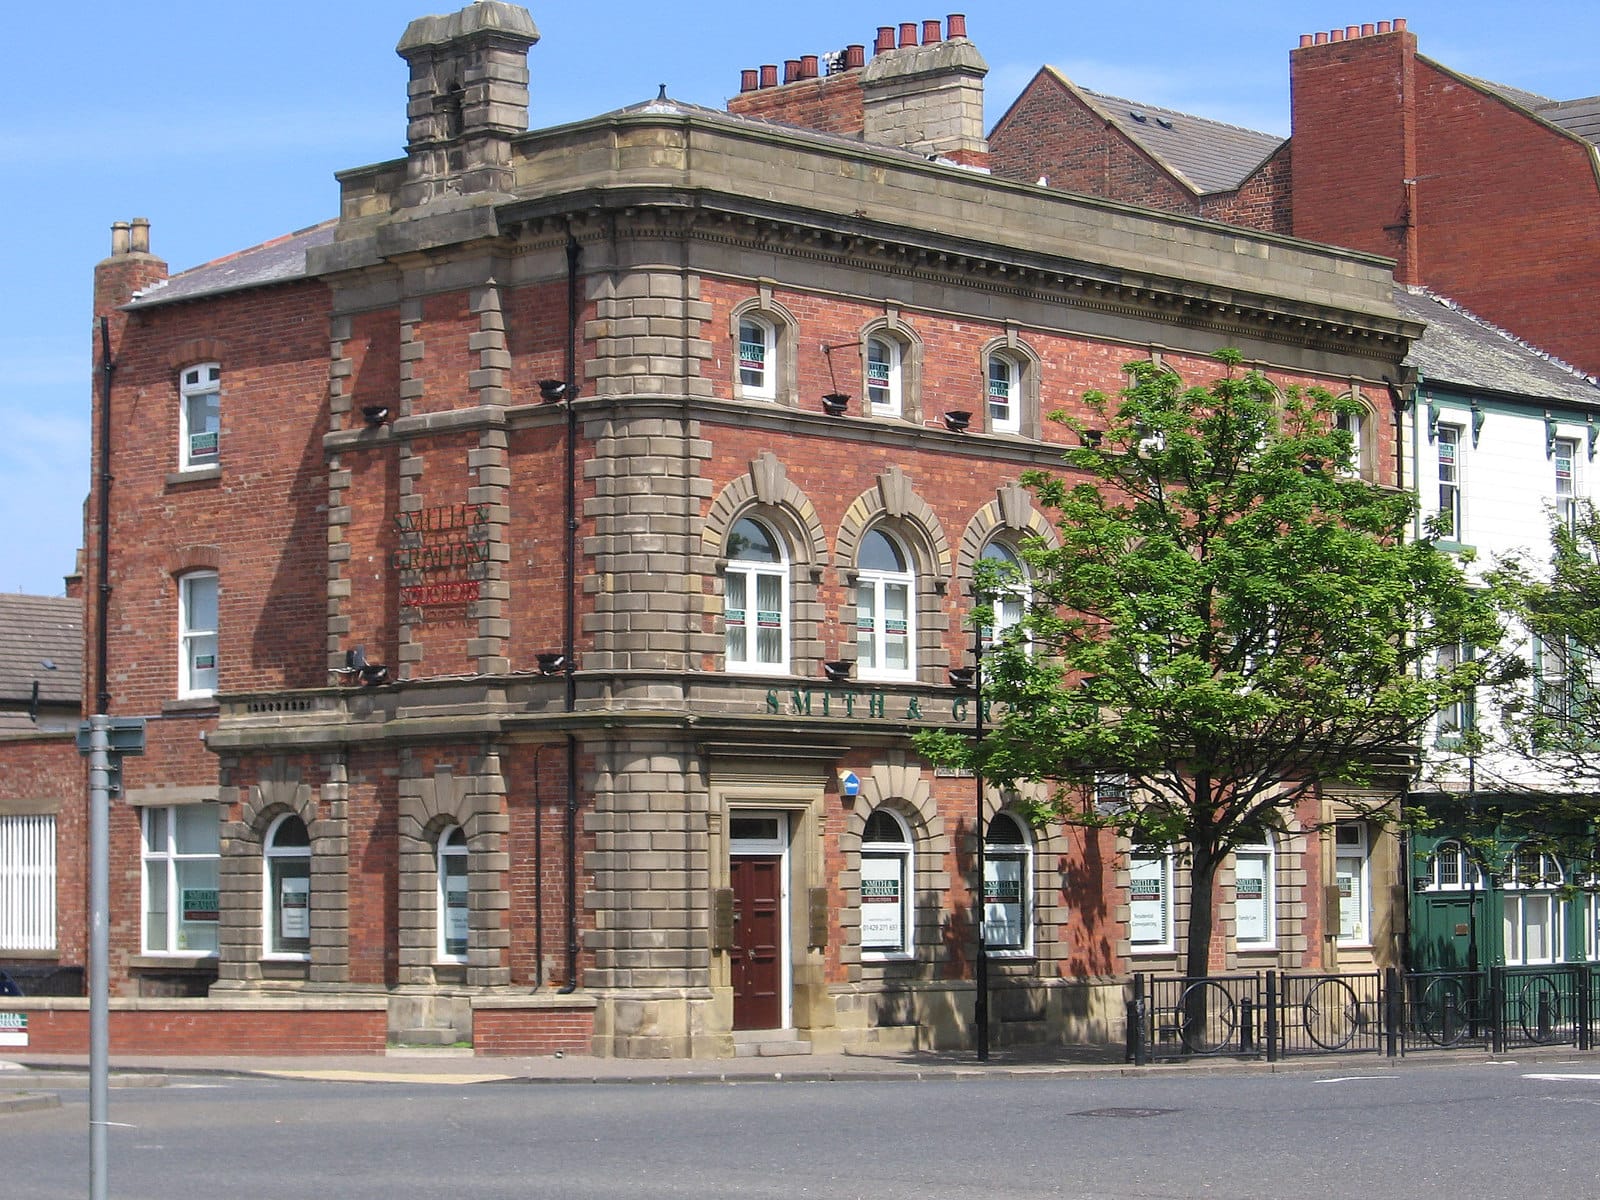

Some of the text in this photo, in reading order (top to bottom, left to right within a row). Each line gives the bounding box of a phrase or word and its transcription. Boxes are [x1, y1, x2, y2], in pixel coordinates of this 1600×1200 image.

[391, 540, 490, 571] GRAHAM
[766, 687, 886, 719] SMITH
[906, 695, 924, 720] &
